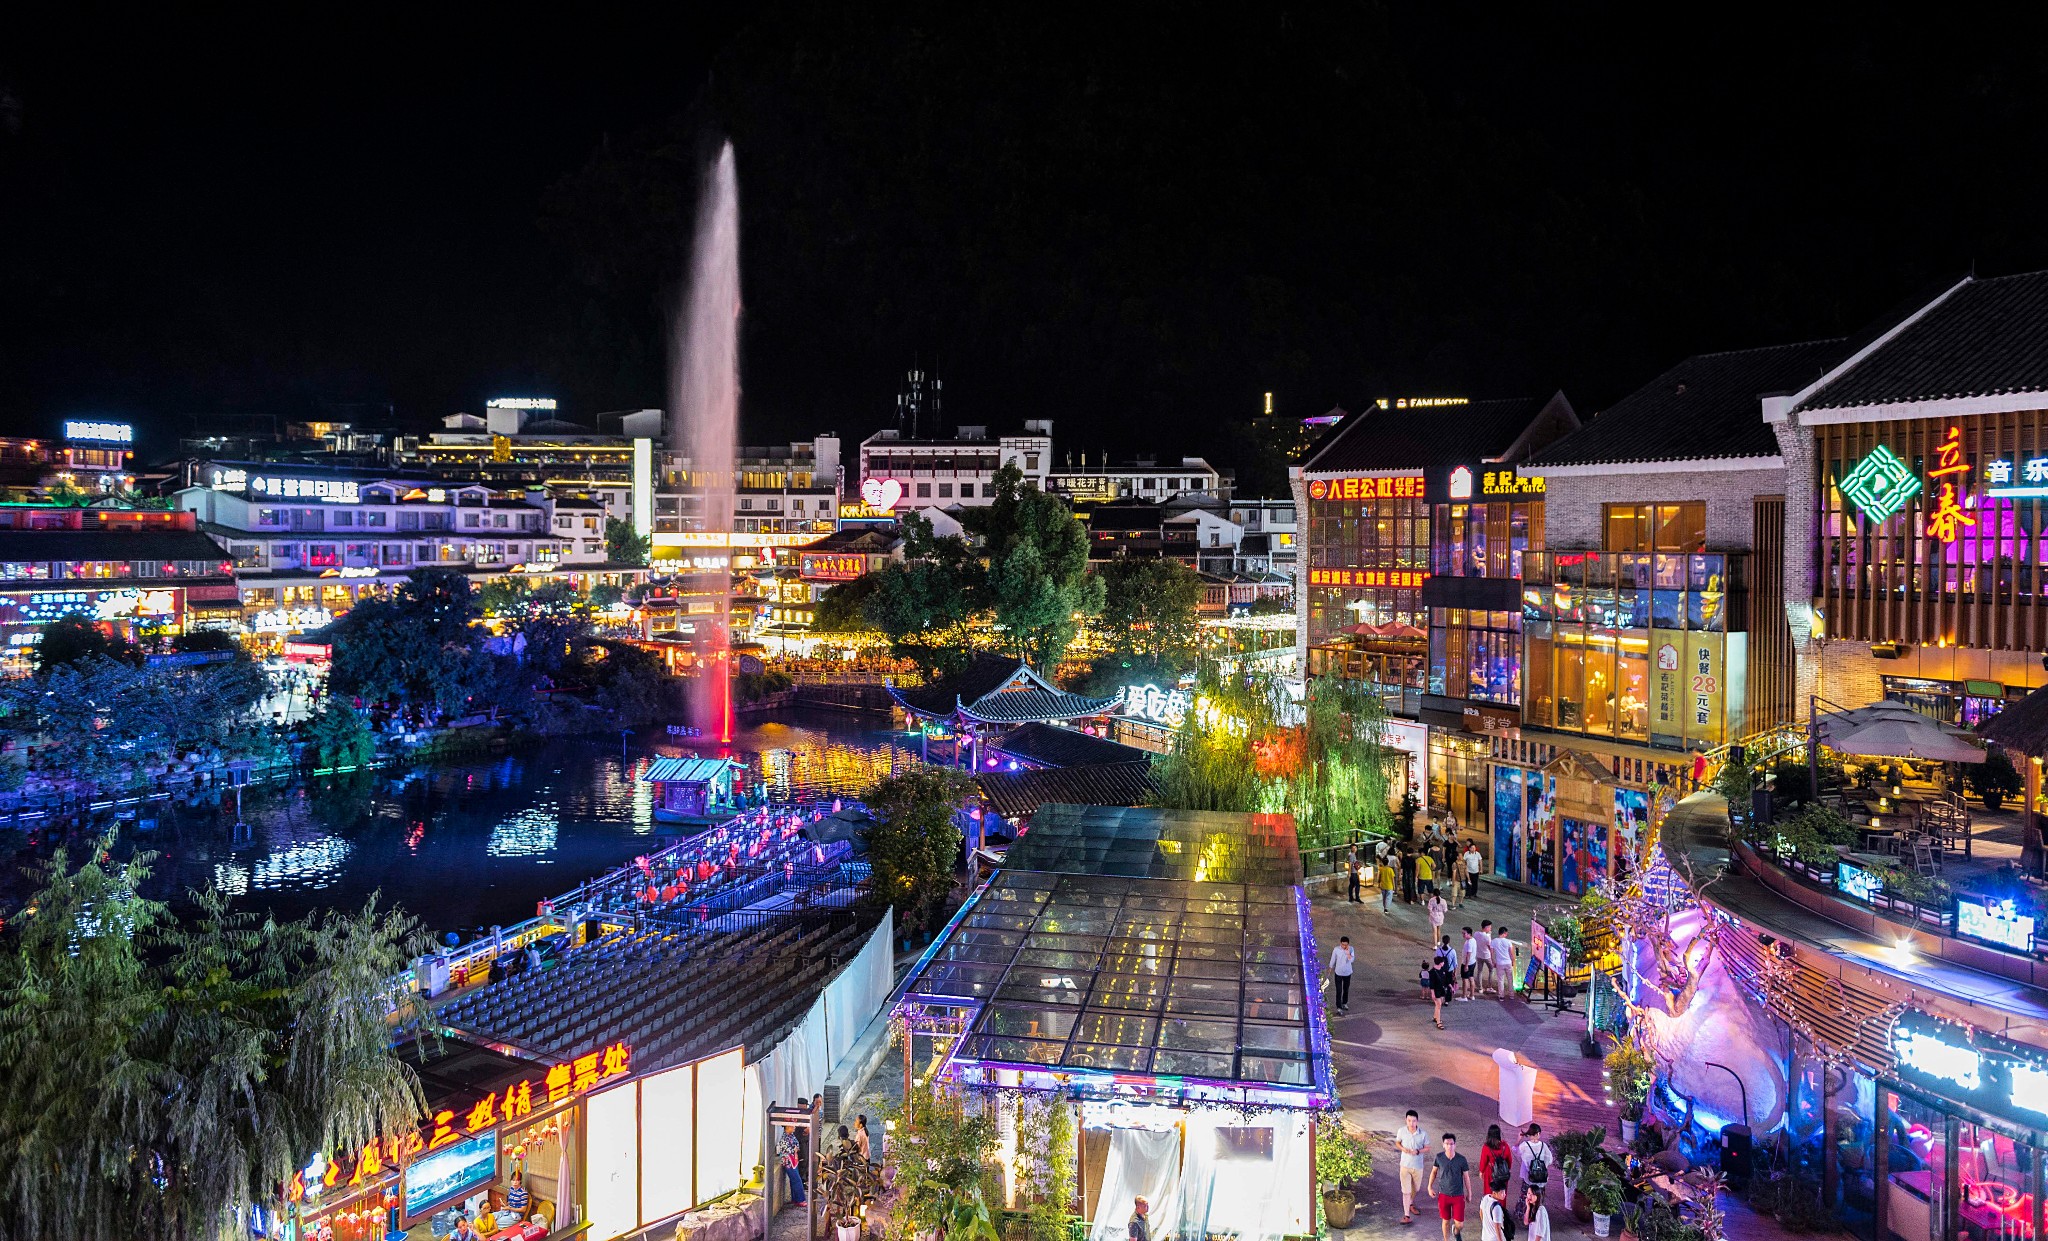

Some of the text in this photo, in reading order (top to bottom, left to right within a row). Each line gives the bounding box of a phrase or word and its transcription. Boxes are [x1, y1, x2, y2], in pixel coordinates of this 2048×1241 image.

[1057, 478, 1097, 489] 春暖花开
[1483, 484, 1519, 494] CLASSIC
[1926, 427, 1976, 543] 立春
[545, 1042, 630, 1102] 售票处
